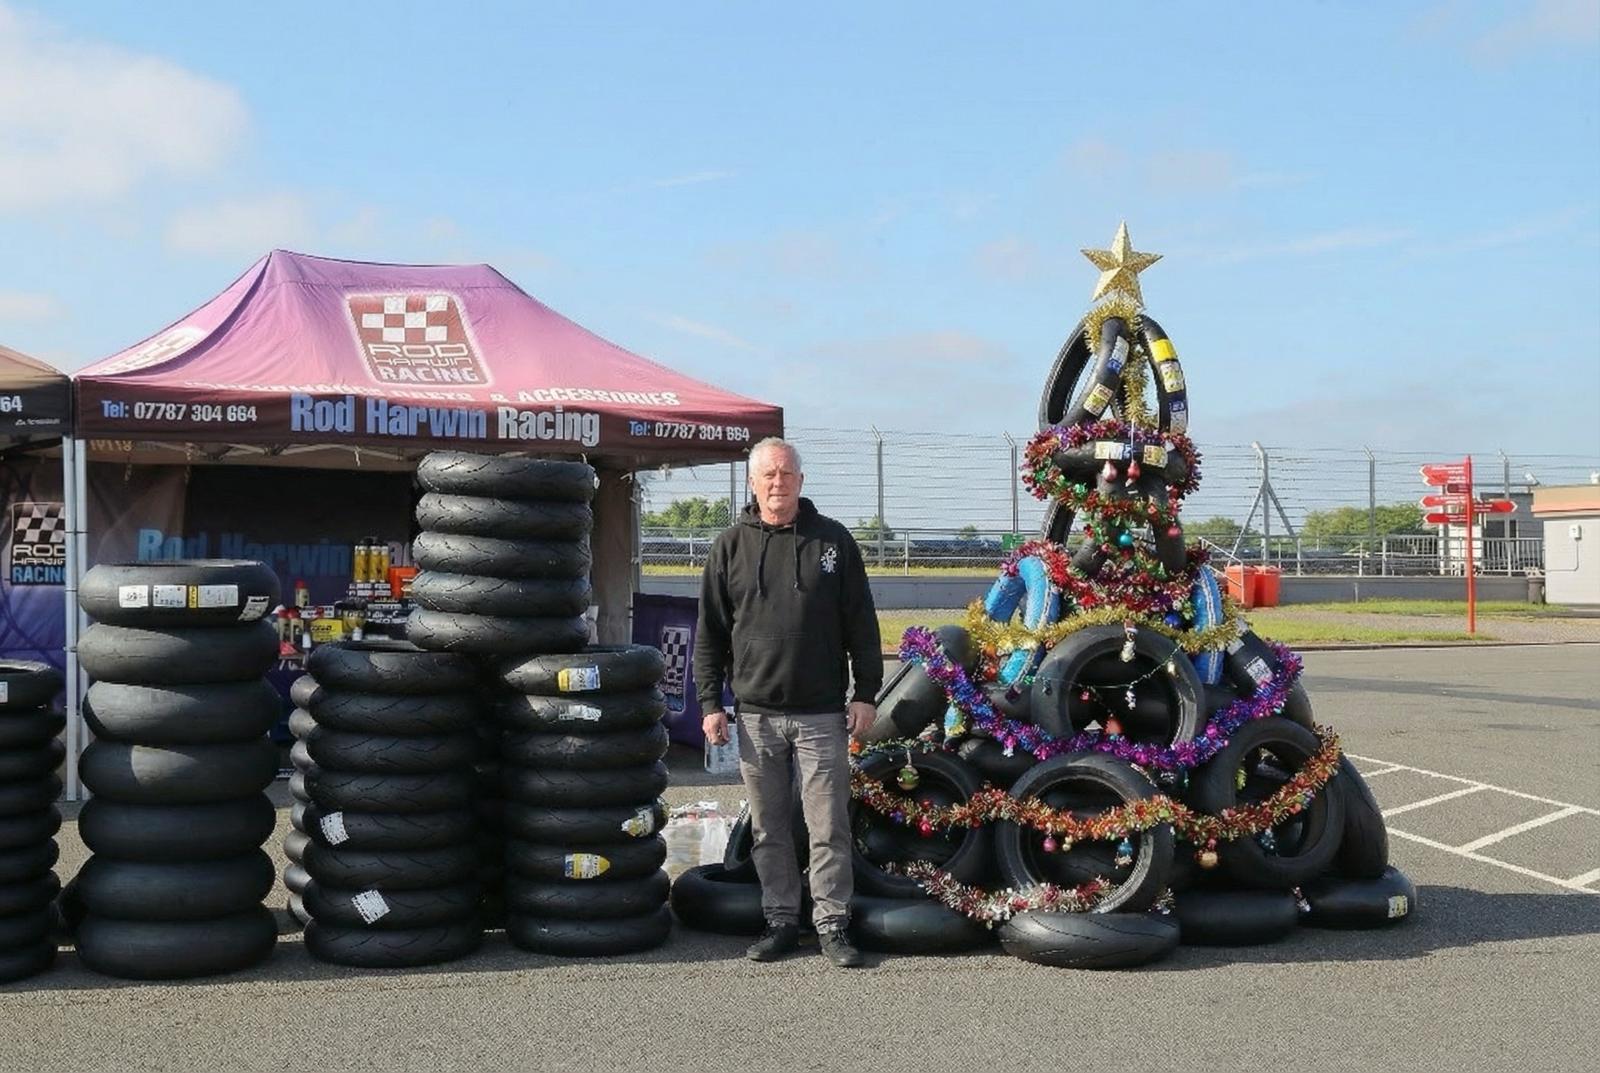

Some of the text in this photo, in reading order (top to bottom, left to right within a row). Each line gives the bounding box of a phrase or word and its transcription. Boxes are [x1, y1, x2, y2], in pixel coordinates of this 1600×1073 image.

[368, 343, 468, 358] ROD
[377, 366, 479, 381] RACING
[518, 388, 681, 406] ACCESSORIES
[101, 400, 257, 422] Tel: 07787 304 664
[290, 392, 600, 447] Rod Harwin Racing
[629, 421, 651, 436] Tel:
[655, 422, 696, 439] 07787
[699, 425, 722, 440] 304
[12, 566, 66, 583] RACIN
